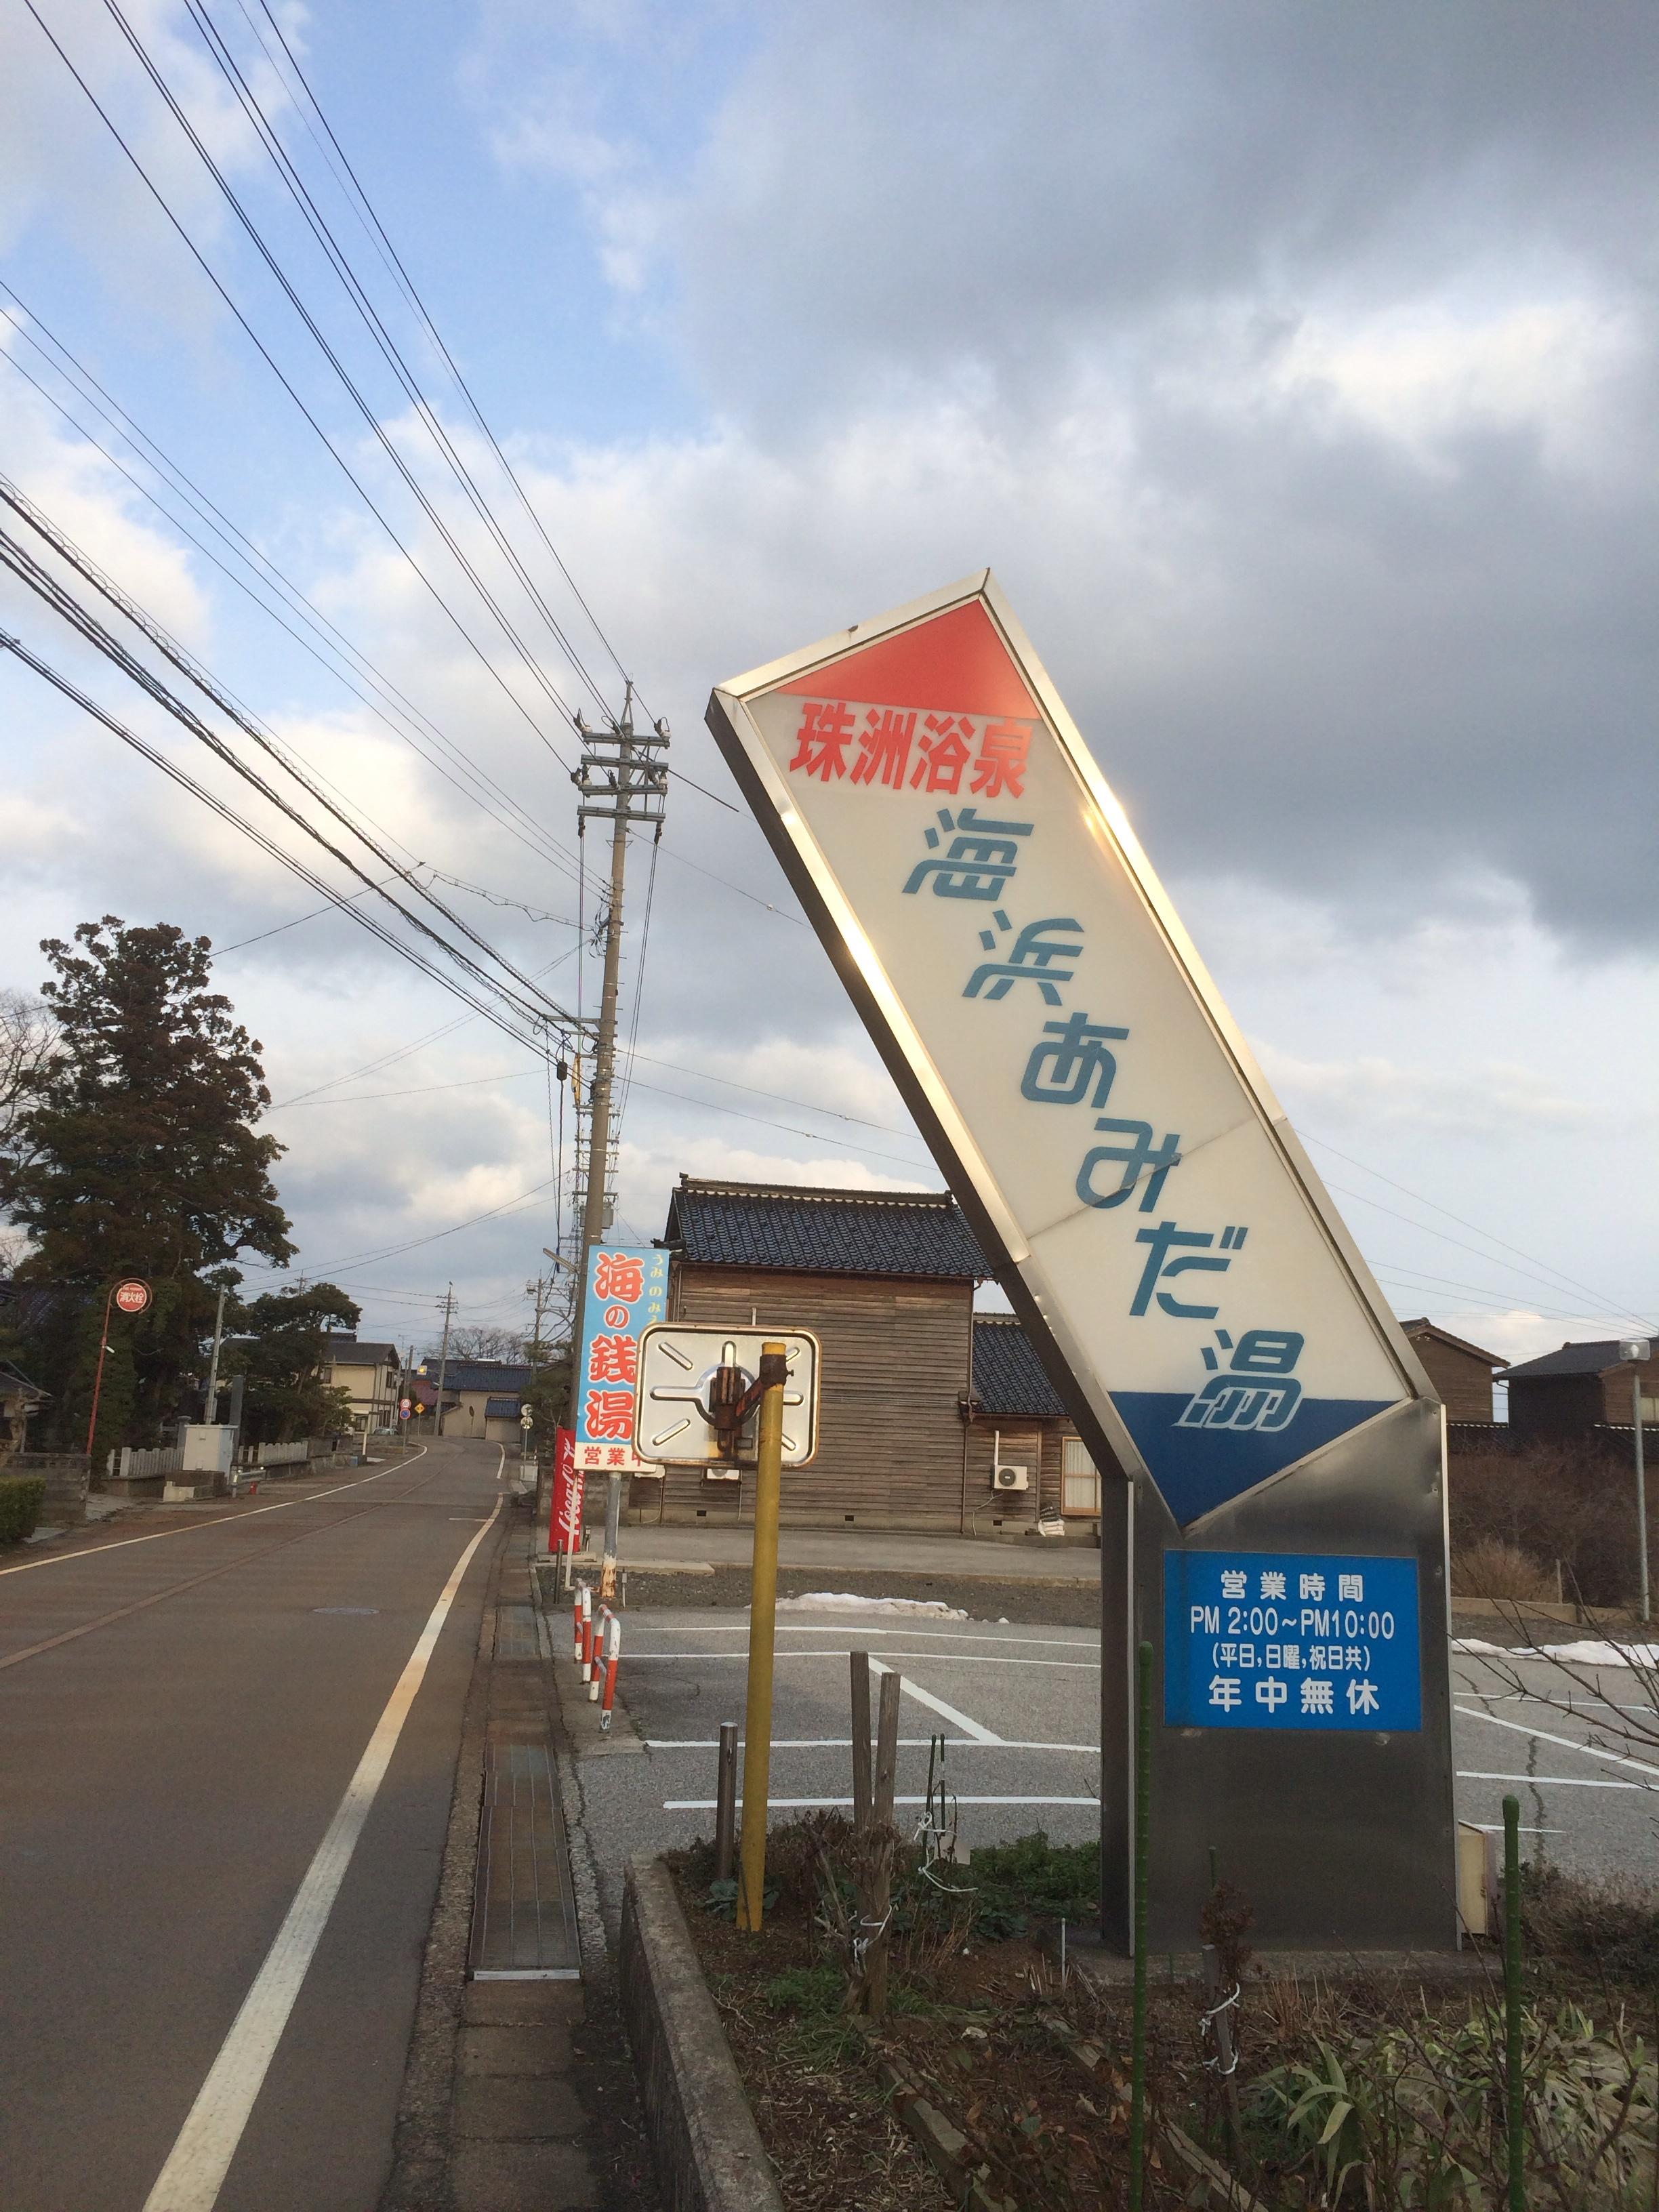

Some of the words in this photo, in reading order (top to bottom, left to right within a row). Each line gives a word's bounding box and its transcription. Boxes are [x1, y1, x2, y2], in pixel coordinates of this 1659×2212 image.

[789, 701, 1033, 799] 珠洲浴泉
[902, 808, 1305, 1433] 海浜あみだ湯
[119, 1292, 144, 1304] 消火栓
[586, 1253, 644, 1439] 海の銭湯
[1221, 1570, 1364, 1602] 営業時間
[1191, 1605, 1220, 1634] PM
[1208, 1675, 1380, 1715] 年中無休
